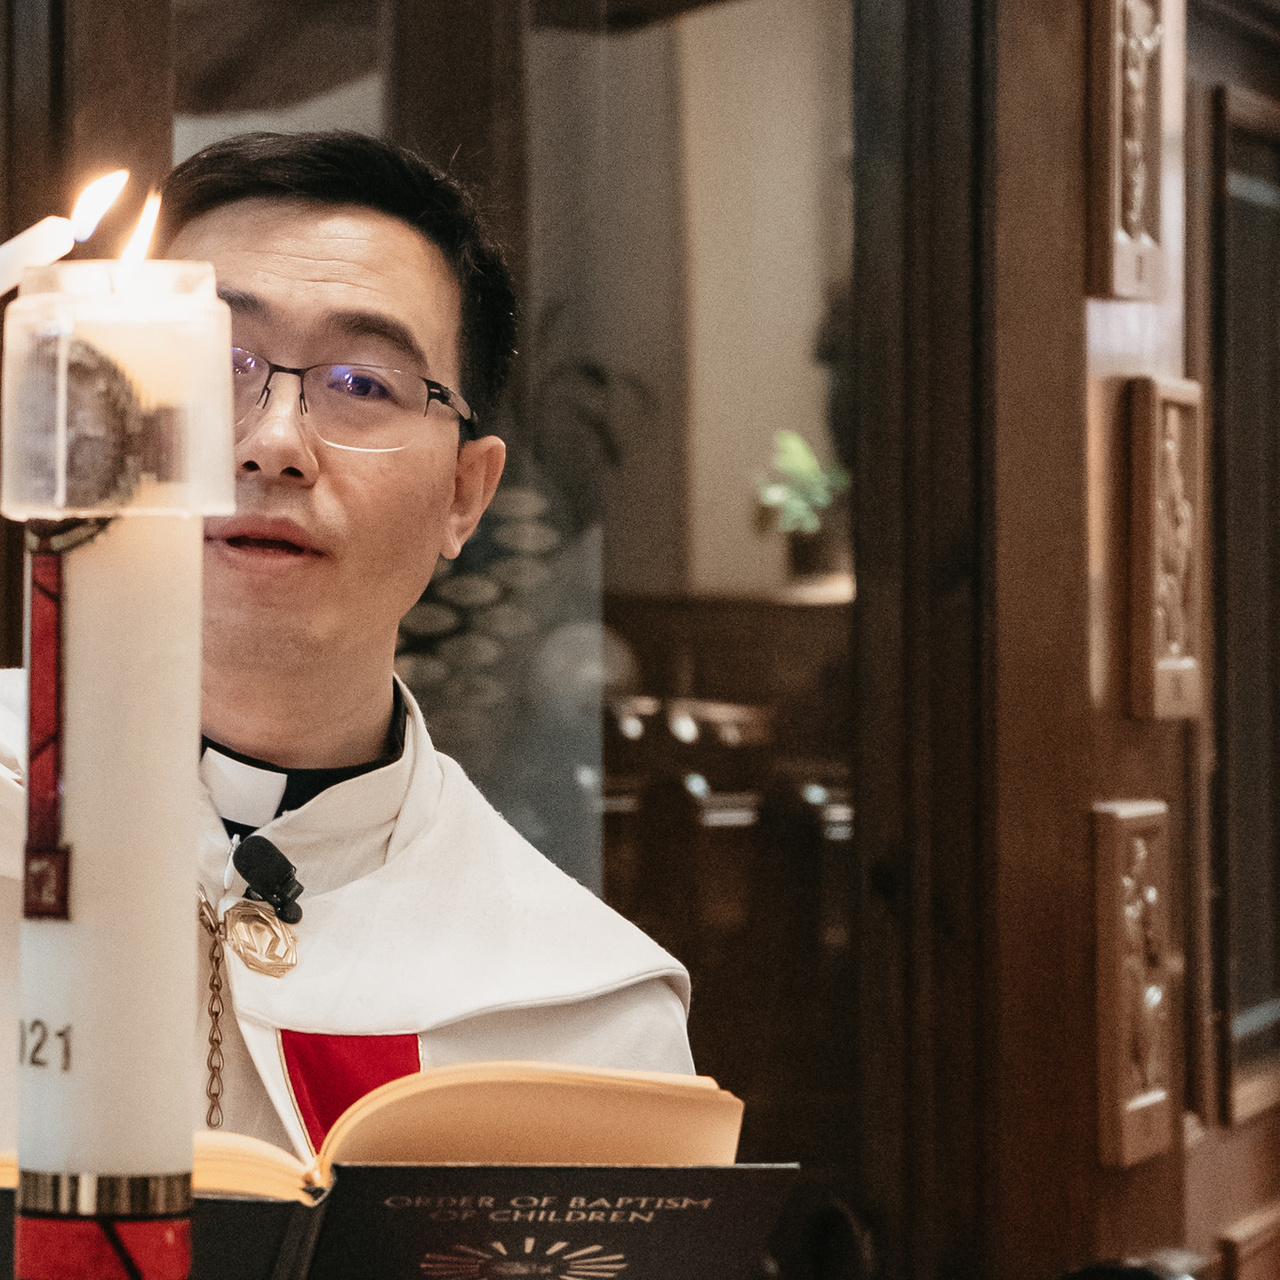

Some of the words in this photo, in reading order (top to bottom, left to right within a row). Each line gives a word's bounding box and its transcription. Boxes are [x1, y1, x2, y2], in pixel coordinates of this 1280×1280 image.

[383, 1194, 496, 1209] ORDER
[509, 1194, 558, 1209] OF
[568, 1194, 713, 1209] BAPTISM
[430, 1209, 477, 1222] OF
[488, 1209, 656, 1223] CHILDREN
